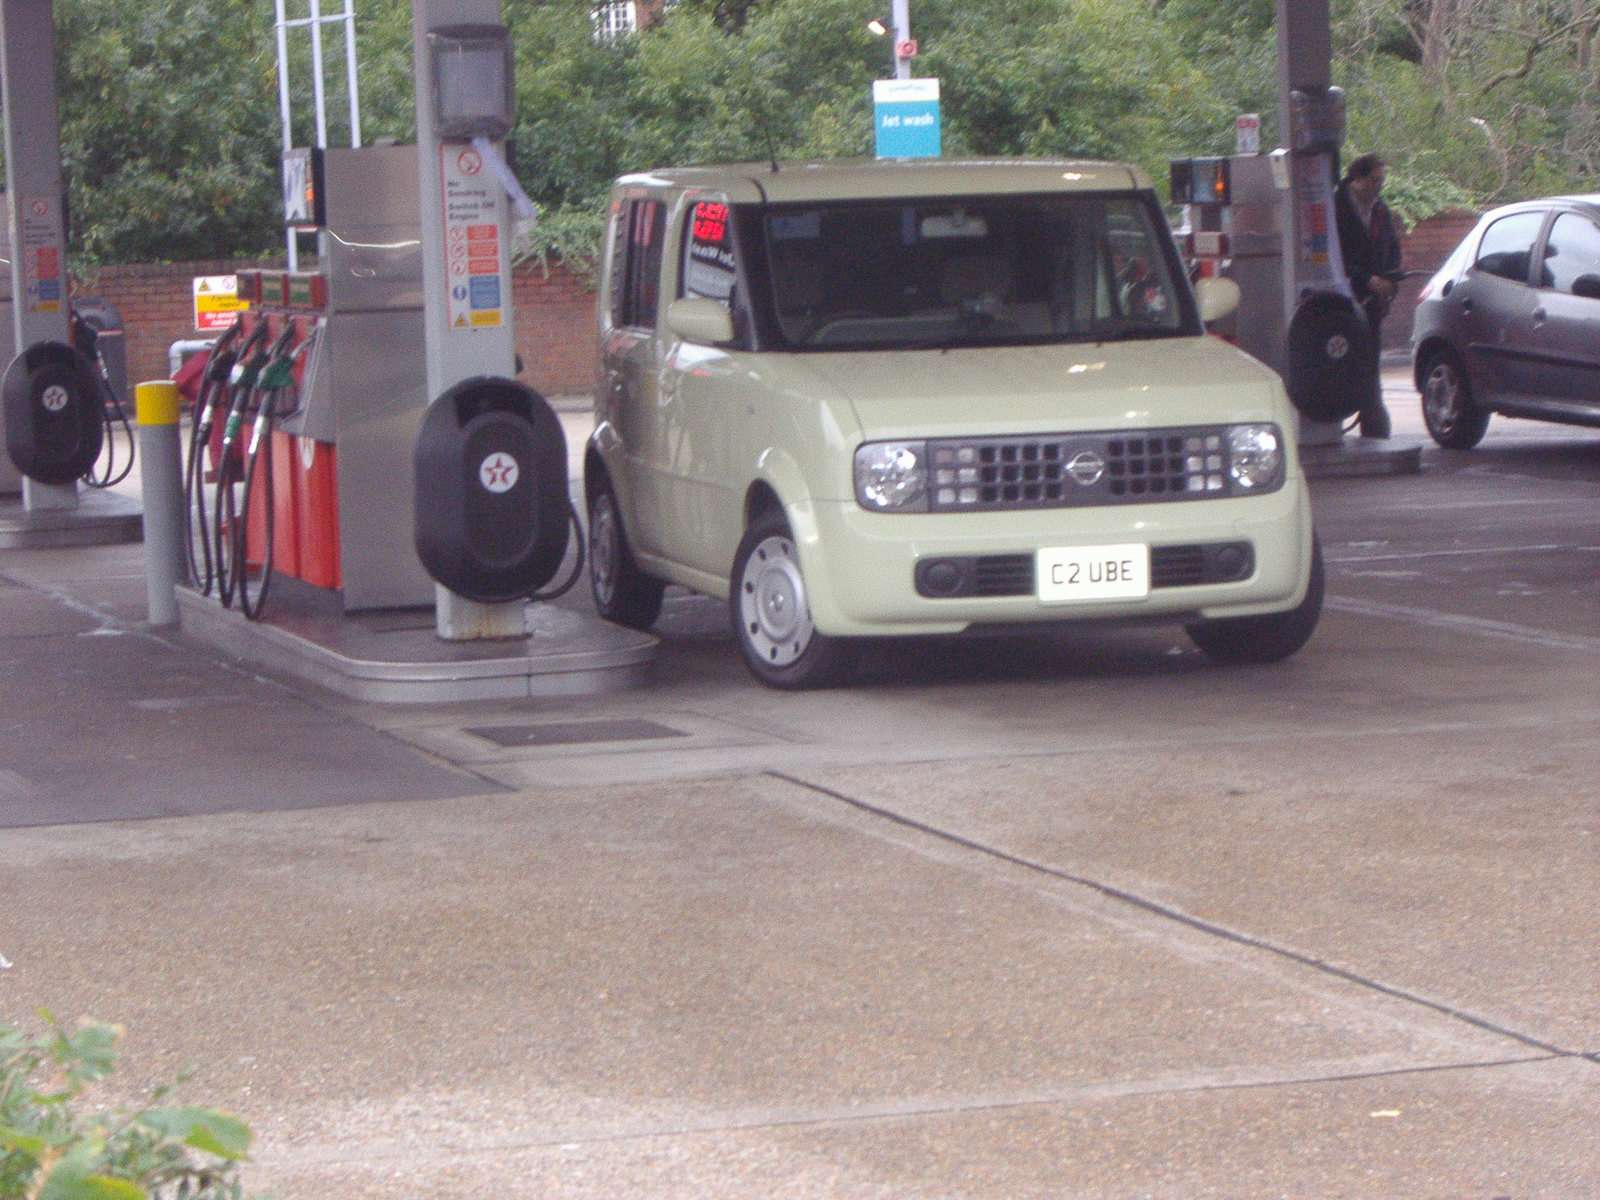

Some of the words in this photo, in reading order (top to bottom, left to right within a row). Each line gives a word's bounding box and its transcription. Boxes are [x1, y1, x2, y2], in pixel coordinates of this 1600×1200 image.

[881, 114, 900, 128] Jet
[902, 113, 935, 128] wash
[1051, 562, 1081, 585] C2
[1088, 559, 1134, 583] UBE
